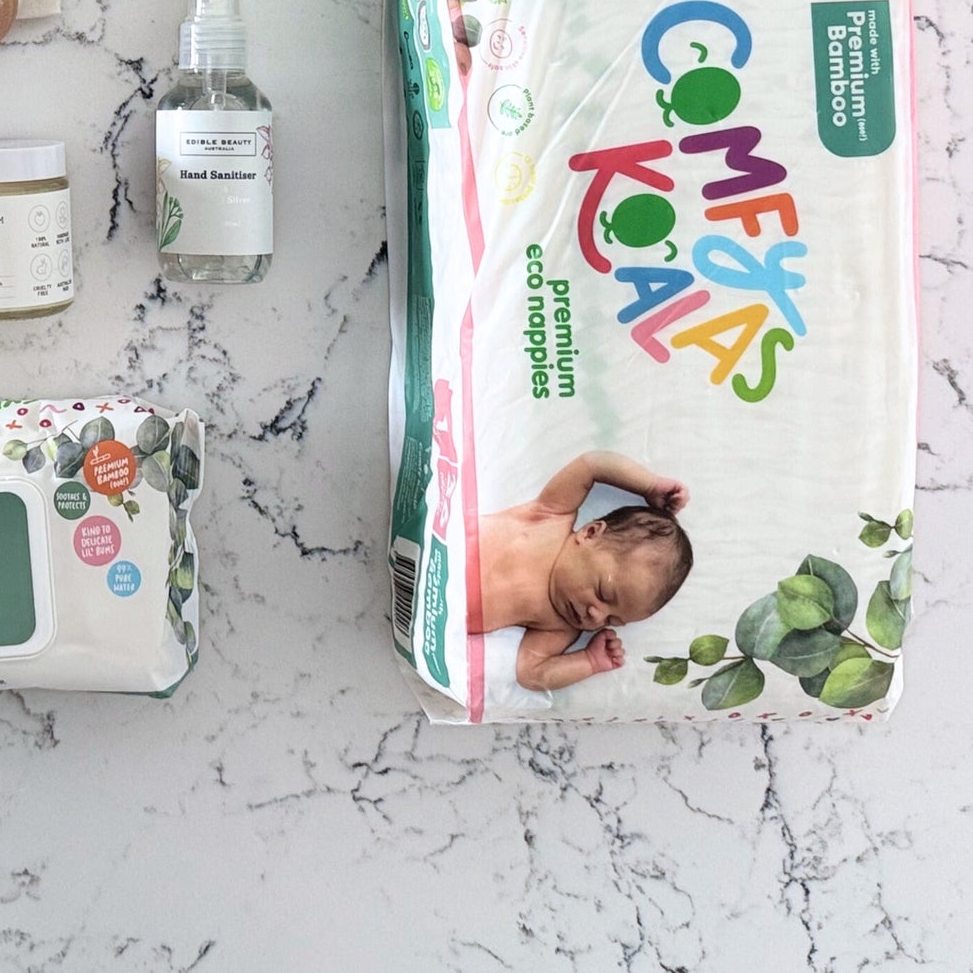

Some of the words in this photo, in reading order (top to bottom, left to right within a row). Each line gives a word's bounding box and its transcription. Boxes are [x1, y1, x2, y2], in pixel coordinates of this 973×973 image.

[868, 9, 879, 45] made
[847, 11, 869, 117] Premium
[870, 48, 881, 75] with
[827, 25, 849, 127] Bamboo
[180, 170, 207, 179] Hand
[210, 170, 257, 180] Sanitiser
[525, 243, 543, 289] eco
[569, 139, 795, 403] KOALAS
[523, 296, 555, 399] nappies
[545, 279, 579, 398] premium
[93, 457, 129, 477] PREMIUM
[96, 467, 129, 485] BAMBOO
[57, 501, 86, 510] PROTECTS
[81, 525, 101, 537] KIND
[101, 525, 111, 535] TO
[81, 535, 113, 548] DELICATE
[95, 544, 115, 556] BUMS
